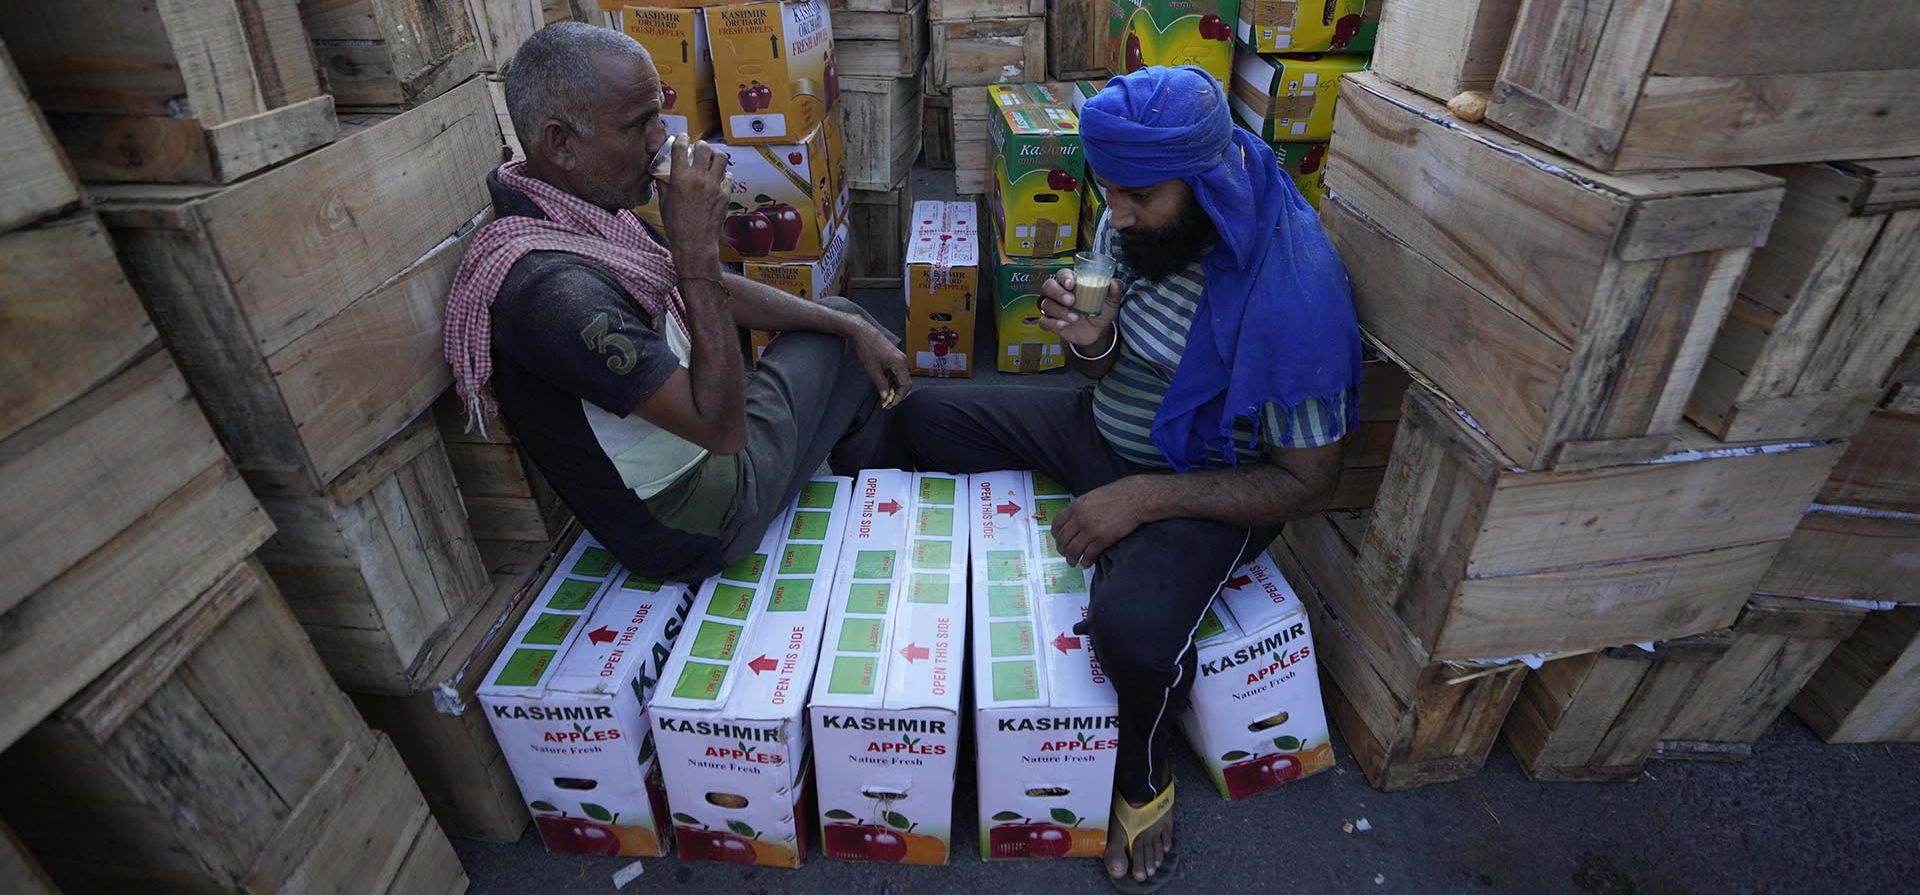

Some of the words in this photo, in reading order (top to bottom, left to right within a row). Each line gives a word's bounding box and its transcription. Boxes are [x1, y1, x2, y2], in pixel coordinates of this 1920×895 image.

[635, 10, 680, 22] KASHMIR
[721, 9, 767, 20] KASHMIR
[725, 18, 764, 27] ORCHARD
[631, 25, 655, 35] FRESH
[656, 28, 686, 38] APPLES
[638, 19, 677, 29] ORCHARD
[718, 26, 743, 35] FRESH
[743, 25, 774, 34] APPLES
[864, 477, 878, 500] OPEN
[980, 482, 991, 502] OPEN
[861, 500, 875, 521] THIS
[981, 502, 992, 522] THIS
[858, 521, 872, 539] SIDE
[982, 521, 994, 539] SIDE
[1249, 564, 1269, 584] THIS
[774, 586, 785, 605] KHATA
[1263, 581, 1285, 604] OPEN
[937, 616, 950, 639] SIDE
[600, 648, 624, 677] OPEN
[617, 625, 639, 647] THIS
[632, 603, 653, 624] SIDE
[934, 640, 948, 667] THIS
[1201, 622, 1306, 677] KASHMIR
[772, 671, 790, 705] OPEN
[781, 646, 799, 676] THIS
[793, 625, 805, 651] SIDE
[1247, 646, 1311, 685] APPLES
[932, 666, 946, 696] OPEN
[1232, 684, 1268, 701] Nature
[1270, 671, 1297, 689] Fresh
[493, 705, 614, 721] KASHMIR
[658, 717, 780, 743] KASHMIR
[823, 715, 947, 734] KASHMIR
[998, 716, 1120, 732] KASHMIR
[543, 729, 621, 744] APPLES
[1040, 739, 1119, 752] APPLES
[530, 744, 568, 755] Nature
[570, 745, 603, 755] Fresh
[704, 746, 785, 764] APPLES
[866, 741, 947, 755] APPLES
[688, 758, 727, 770] Nature
[729, 763, 761, 775] Fresh
[849, 754, 889, 765] Nature
[891, 756, 923, 766] Fresh
[1022, 755, 1061, 764] Nature
[1064, 754, 1096, 763] Fresh
